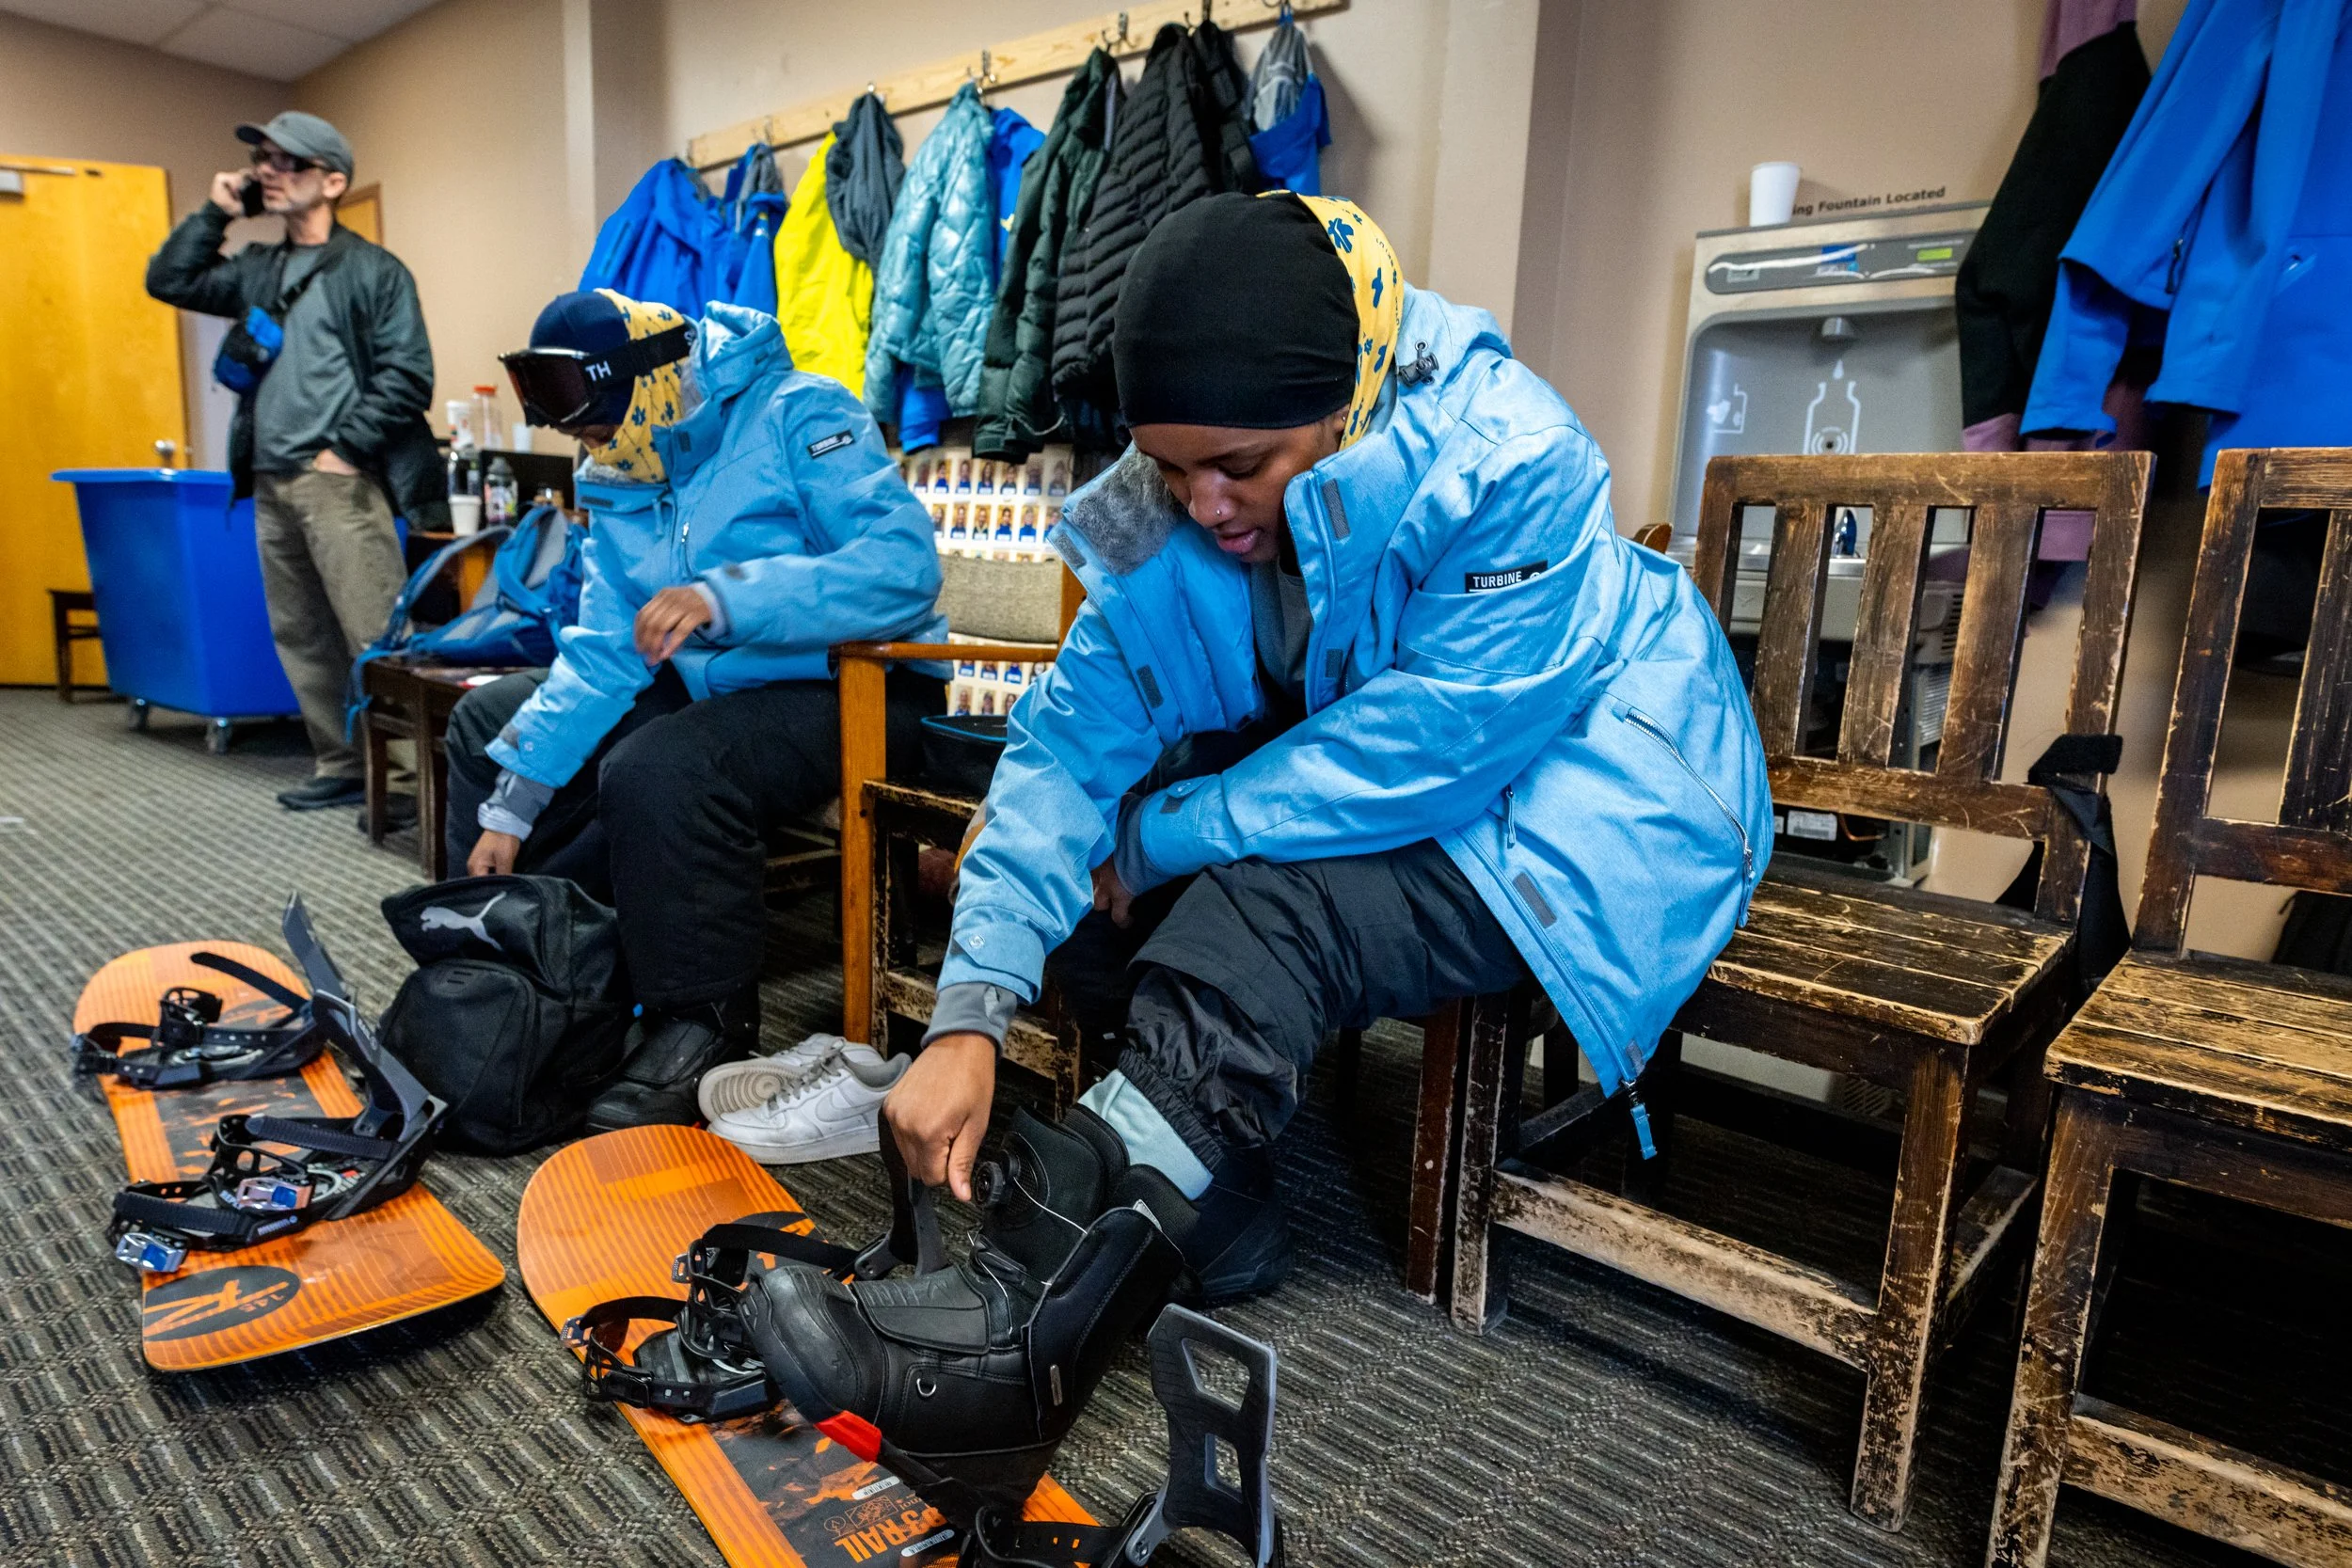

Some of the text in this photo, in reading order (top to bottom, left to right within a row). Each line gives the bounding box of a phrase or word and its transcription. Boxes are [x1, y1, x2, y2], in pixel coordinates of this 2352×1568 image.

[1792, 203, 1814, 216] ing
[1818, 195, 1882, 212] Fountain
[1886, 185, 1947, 204] Located
[1472, 570, 1522, 588] TURBINE
